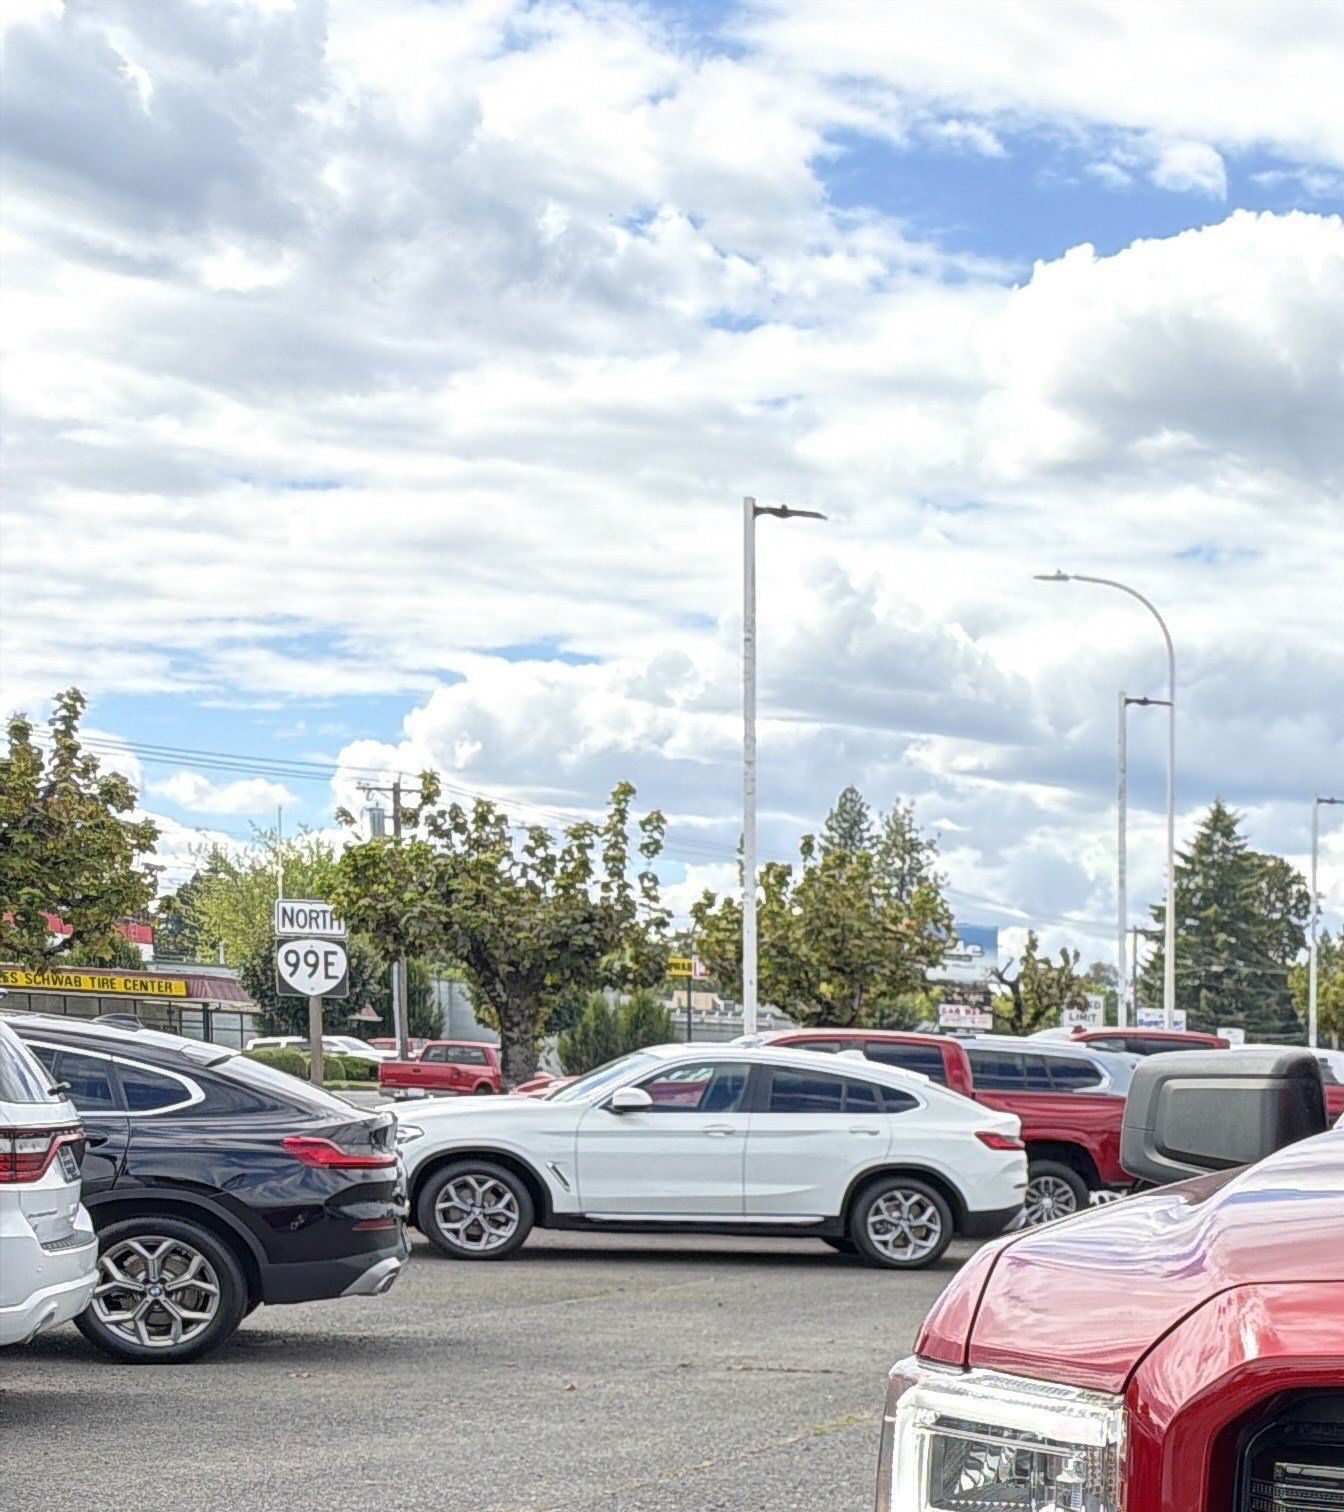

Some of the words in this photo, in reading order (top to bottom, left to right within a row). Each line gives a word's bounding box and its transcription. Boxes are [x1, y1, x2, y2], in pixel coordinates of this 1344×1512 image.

[281, 905, 342, 931] NORTH
[284, 949, 339, 980] 99E
[24, 972, 82, 988] SCHWAB
[90, 976, 117, 990] TIRE
[123, 978, 173, 994] CENTER
